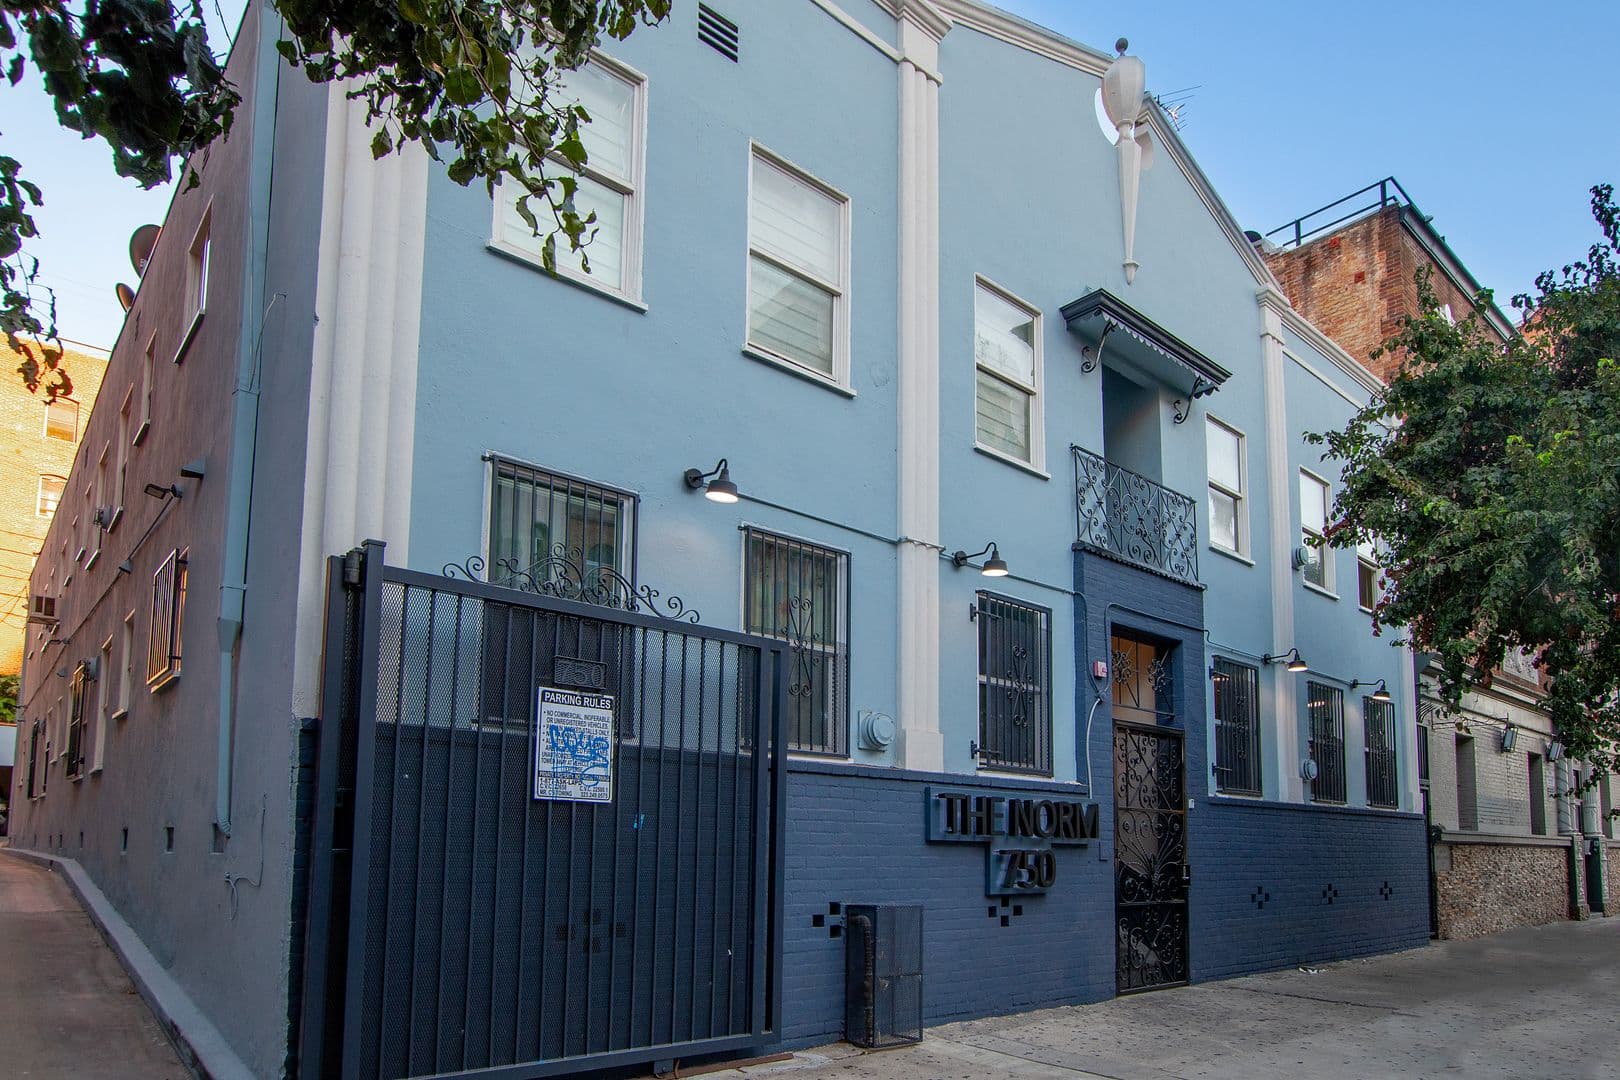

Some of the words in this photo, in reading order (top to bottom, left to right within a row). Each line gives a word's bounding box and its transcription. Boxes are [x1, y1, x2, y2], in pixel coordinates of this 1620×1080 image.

[544, 692, 581, 705] PARKING
[584, 698, 611, 709] RULES
[938, 793, 1005, 836] THE
[1008, 797, 1100, 839] NORM
[995, 849, 1057, 888] 750
